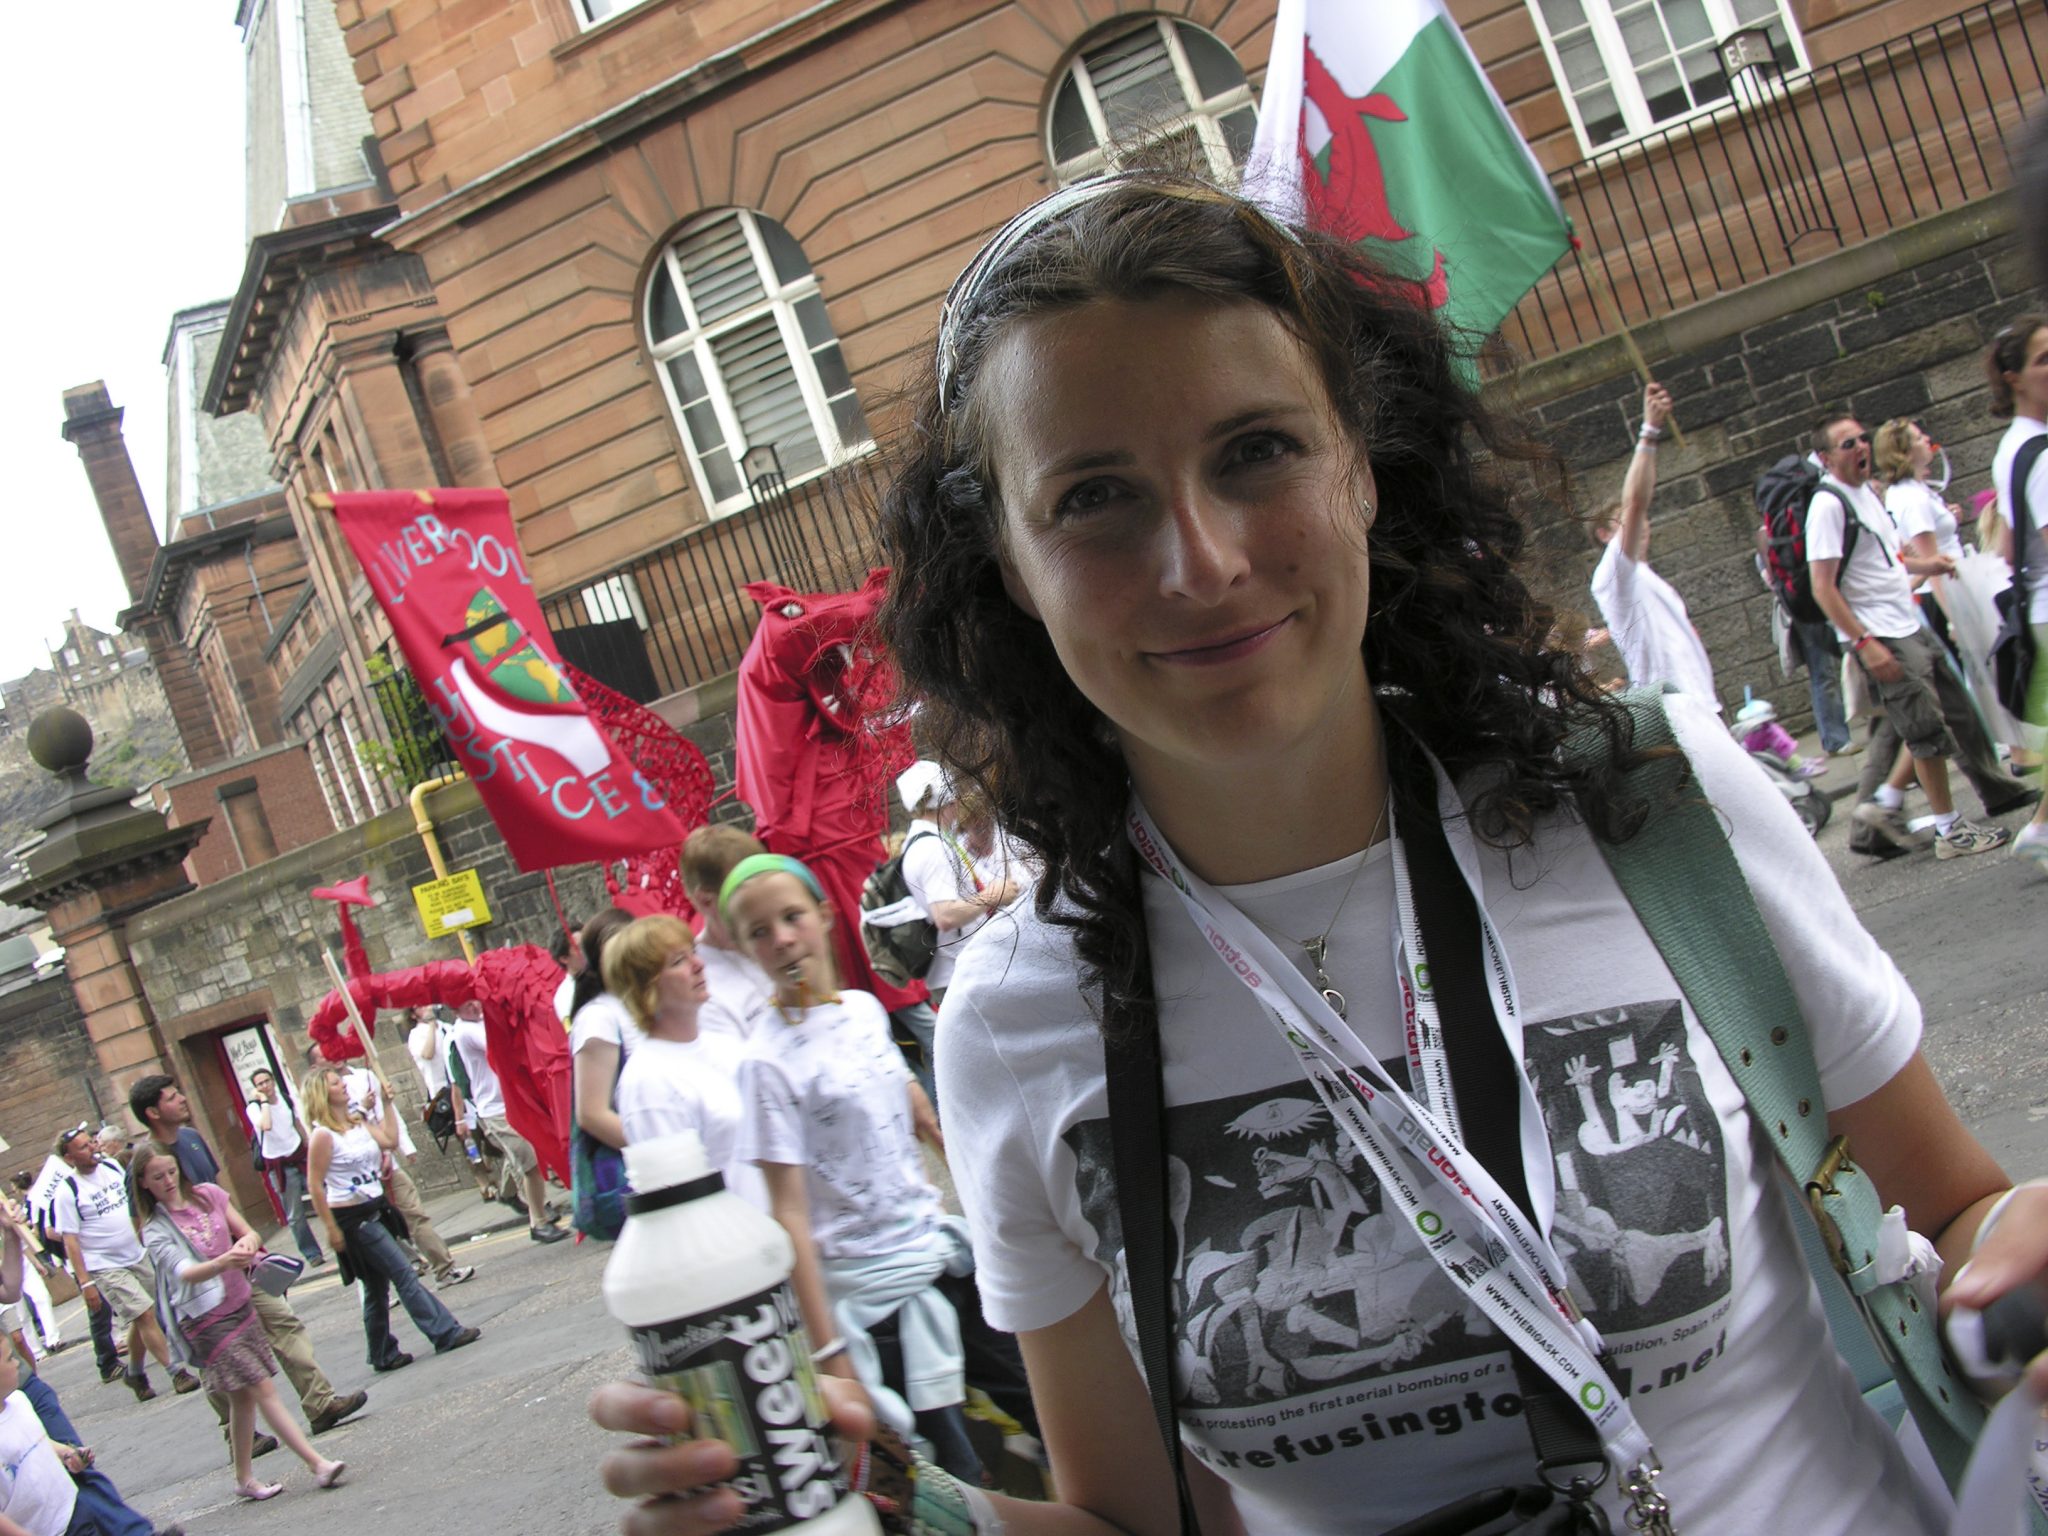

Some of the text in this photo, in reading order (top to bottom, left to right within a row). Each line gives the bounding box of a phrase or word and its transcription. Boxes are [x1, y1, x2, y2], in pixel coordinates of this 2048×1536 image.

[43, 1170, 64, 1200] MAKE
[1346, 1107, 1419, 1207] WWW.THEBIGASK.COM
[1207, 1408, 1277, 1432] protesting
[1279, 1405, 1306, 1421] the
[1308, 1396, 1343, 1416] first
[1345, 1385, 1394, 1405] aerial
[1396, 1370, 1469, 1395] bombing
[1473, 1363, 1491, 1379] of
[1495, 1363, 1506, 1374] a
[1672, 1319, 1708, 1342] Spain
[1485, 1283, 1580, 1380] WWW.THEBIGASK.COM
